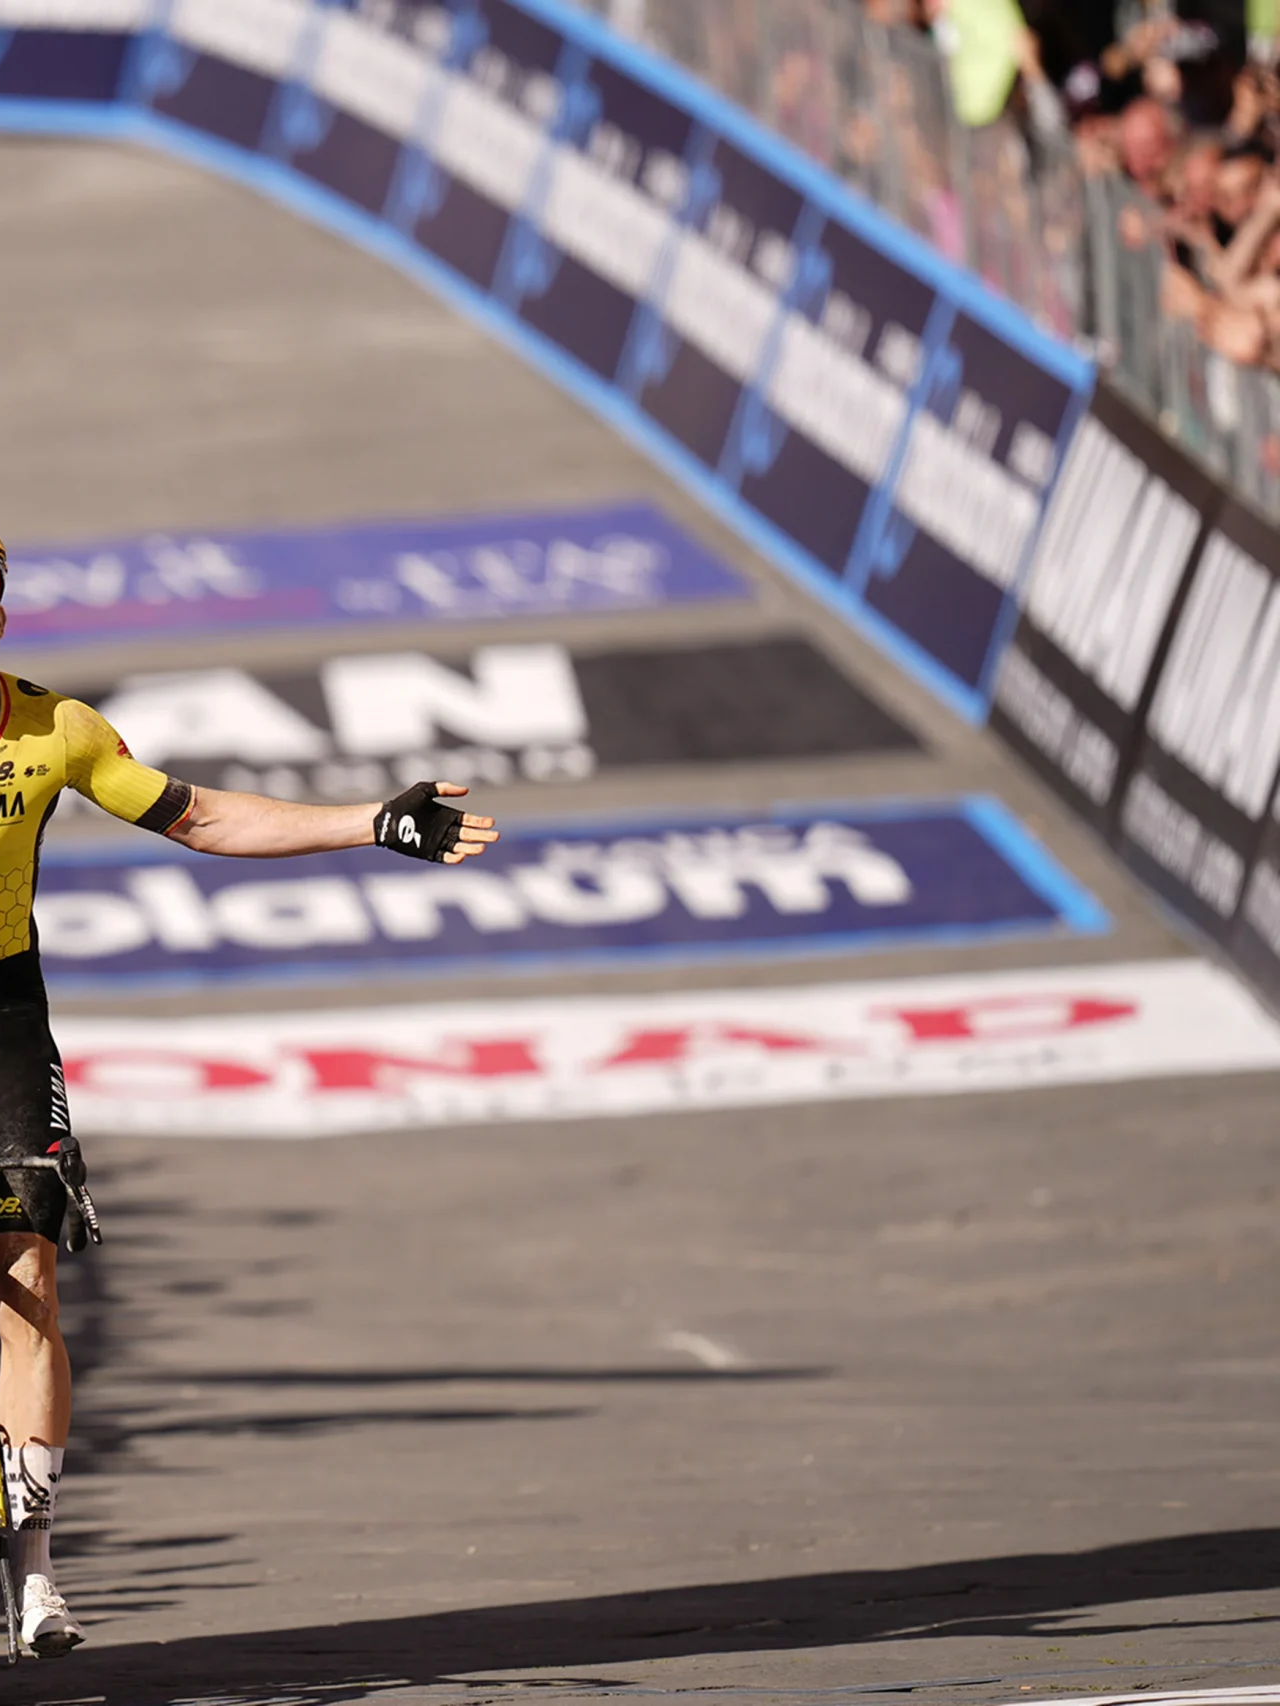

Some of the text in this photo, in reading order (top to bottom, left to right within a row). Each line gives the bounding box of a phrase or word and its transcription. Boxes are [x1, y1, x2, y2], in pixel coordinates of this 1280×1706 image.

[32, 812, 908, 962] olanum
[49, 1062, 69, 1132] VISMA
[60, 992, 1142, 1100] ONAD
